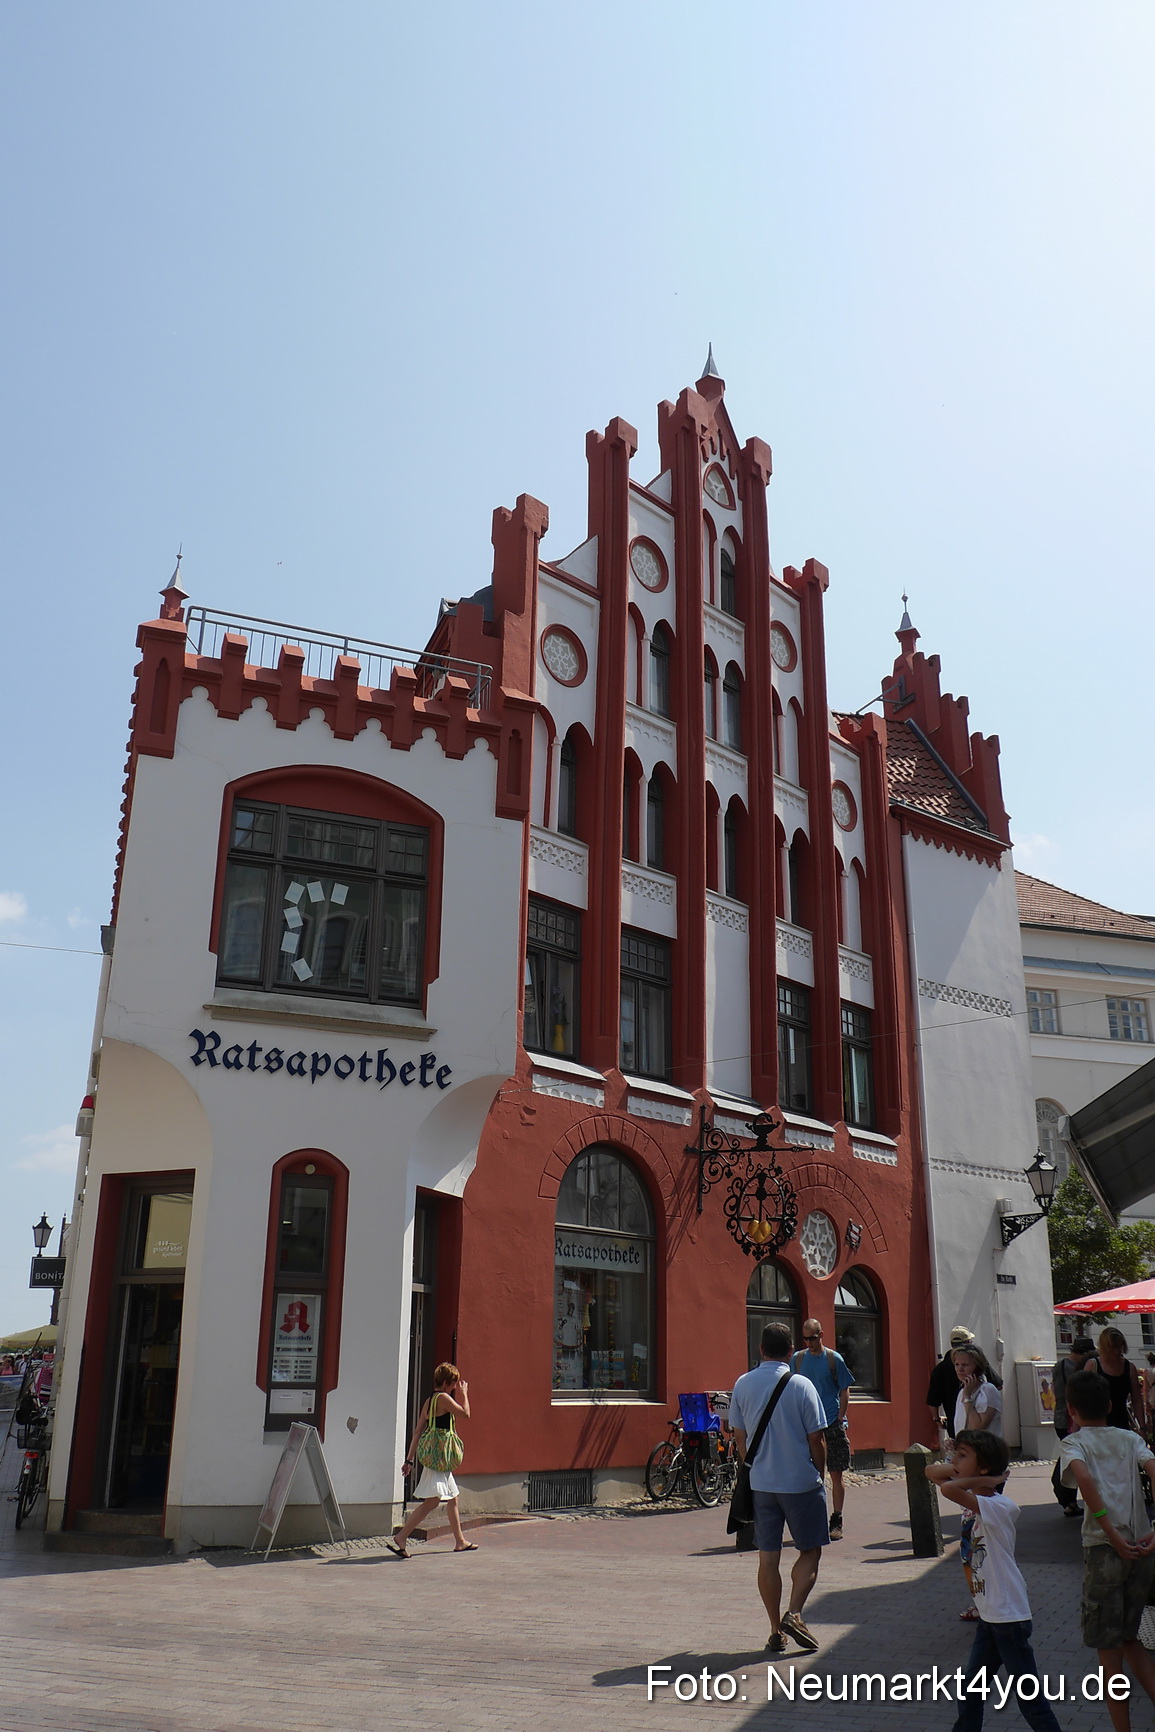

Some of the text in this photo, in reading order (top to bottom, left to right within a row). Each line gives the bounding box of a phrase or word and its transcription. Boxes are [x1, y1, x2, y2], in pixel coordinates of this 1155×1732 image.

[188, 1028, 453, 1090] Ratsapotheke
[555, 1237, 640, 1265] Ratsapotheke
[35, 1270, 65, 1281] BONIT
